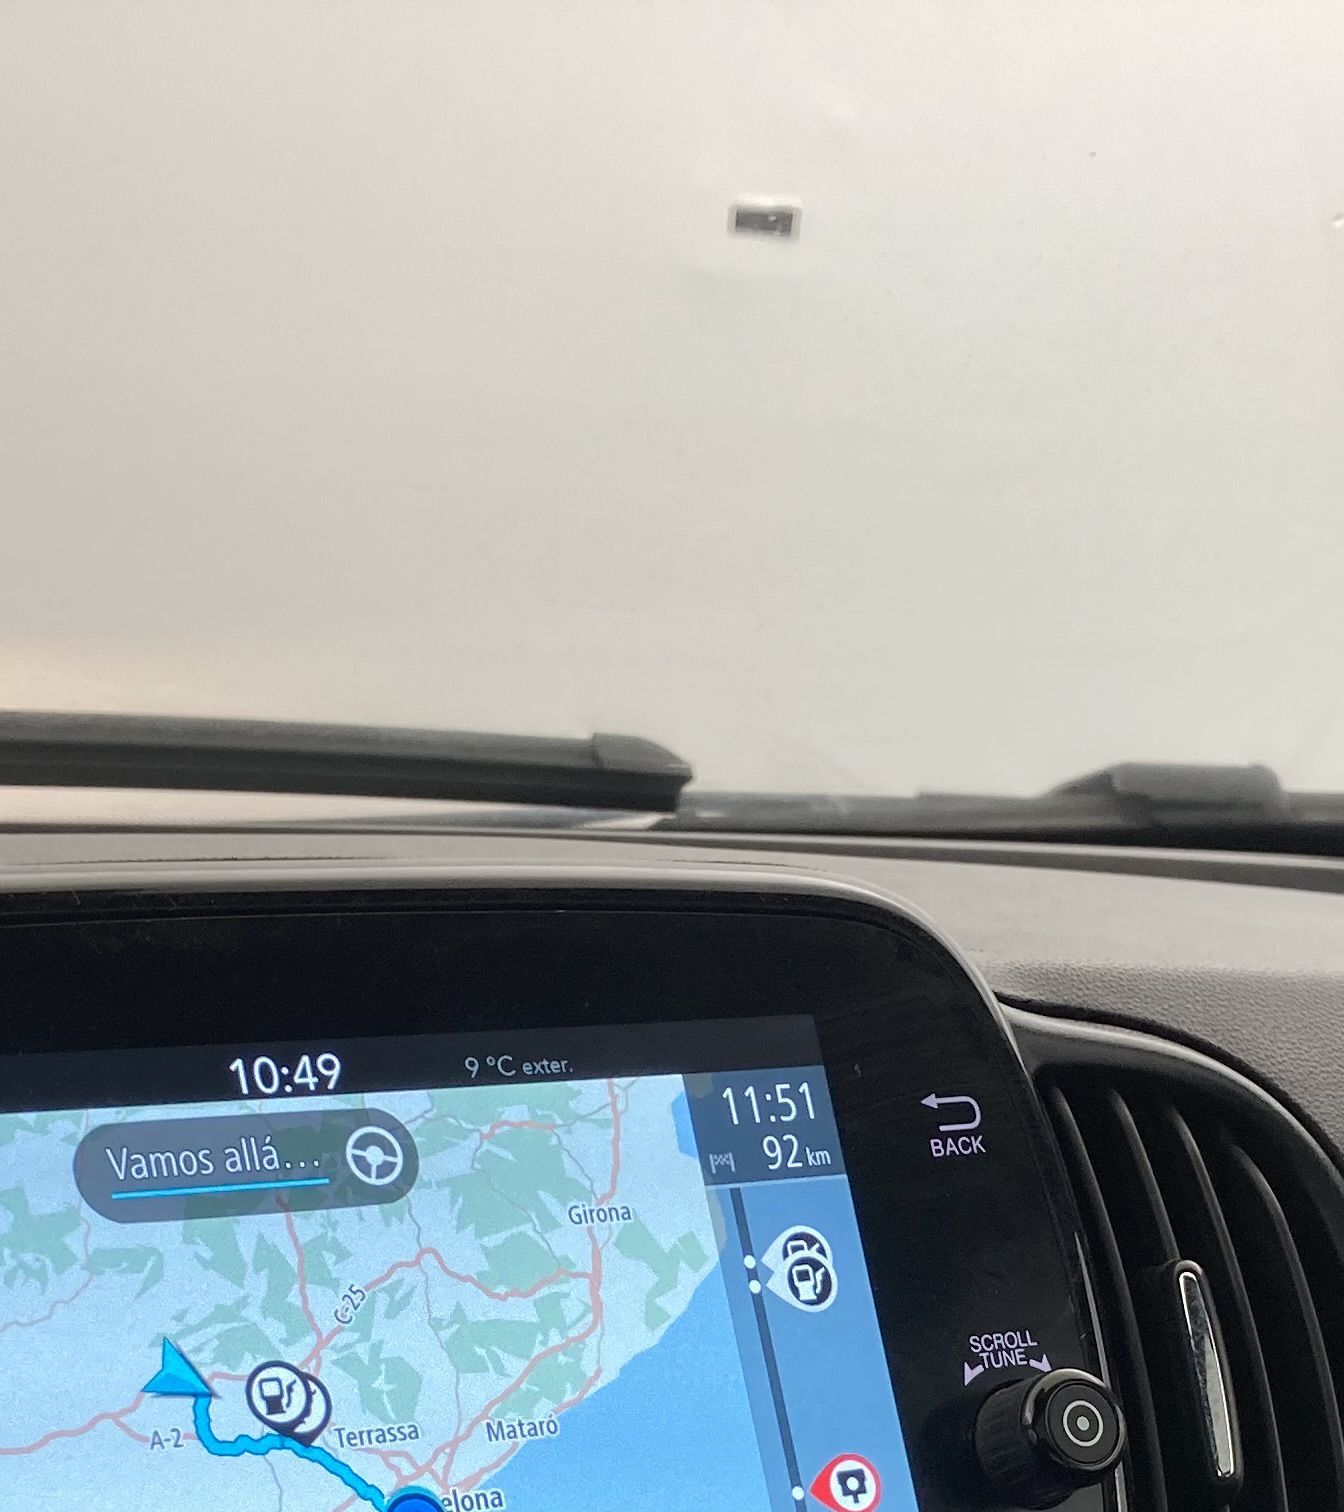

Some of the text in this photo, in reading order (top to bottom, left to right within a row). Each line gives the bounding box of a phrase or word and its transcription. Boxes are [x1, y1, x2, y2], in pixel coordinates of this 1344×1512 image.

[229, 1053, 342, 1096] 10:49
[464, 1055, 574, 1078] 9 °C exter.
[722, 1082, 816, 1125] 11:51
[106, 1135, 320, 1180] Vamos allá...
[763, 1134, 832, 1170] 92 km
[929, 1135, 986, 1157] BACK
[568, 1205, 633, 1226] Girona
[333, 1283, 368, 1325] C-25
[969, 1330, 1038, 1352] SCROLL
[979, 1350, 1028, 1369] TUNE
[149, 1428, 184, 1450] A-2
[335, 1422, 419, 1448] Terrassa
[486, 1413, 559, 1443] Mataró
